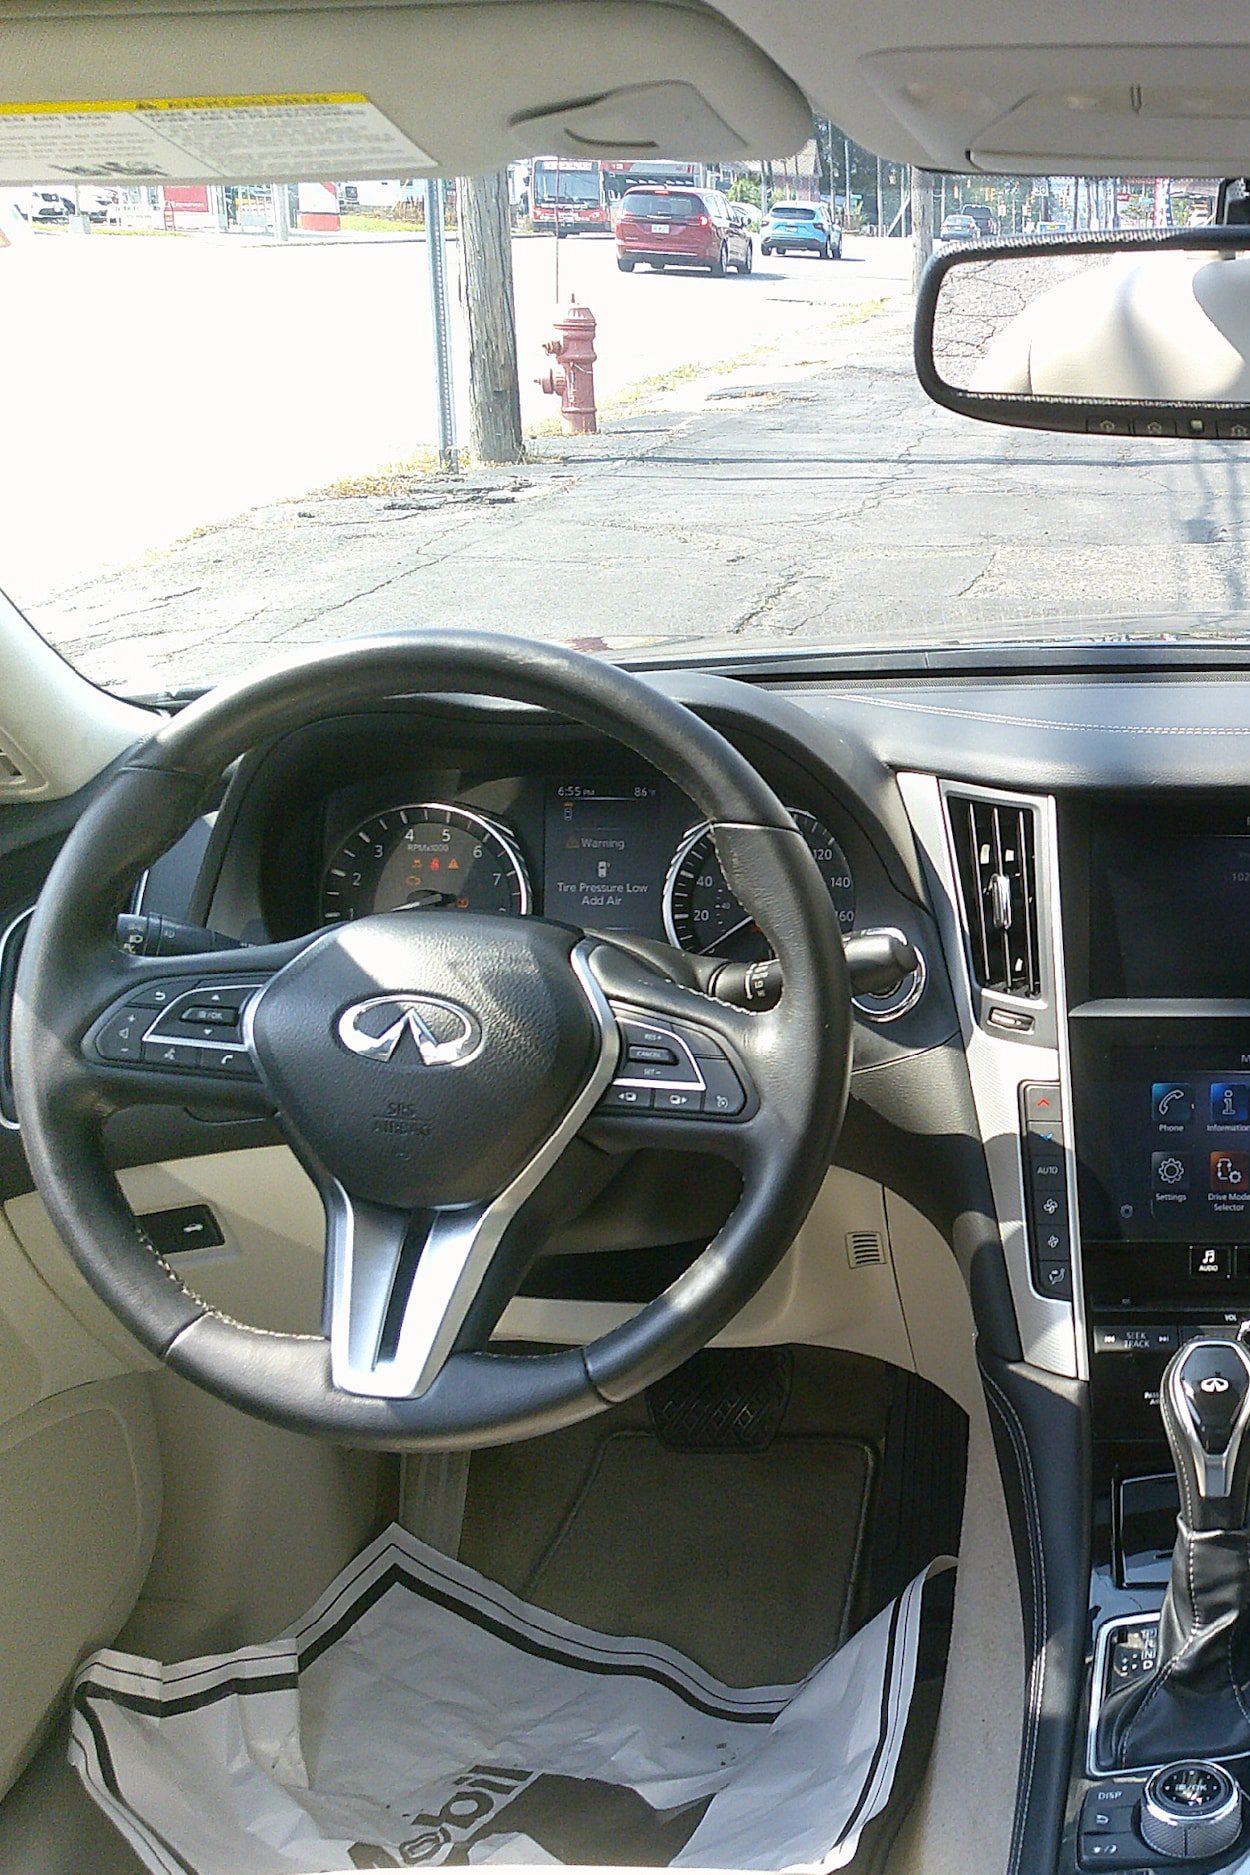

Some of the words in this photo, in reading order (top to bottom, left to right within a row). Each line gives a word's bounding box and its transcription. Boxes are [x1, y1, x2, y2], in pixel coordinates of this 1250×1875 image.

[557, 786, 581, 797] 6:55
[633, 786, 648, 797] 86
[404, 828, 415, 842] 4
[442, 828, 451, 842] 5
[581, 838, 625, 850] Warning
[374, 845, 384, 858] 3
[473, 846, 483, 859] 6
[352, 872, 362, 886] 2
[492, 873, 502, 886] 7
[696, 876, 713, 888] 40
[831, 877, 851, 888] 140
[557, 882, 577, 893] Tire
[579, 883, 624, 893] Pressure
[626, 883, 648, 893] Low
[581, 895, 604, 906] Add
[606, 895, 622, 906] Air
[693, 909, 710, 921] 20
[1159, 1123, 1185, 1133] Phone
[1037, 1165, 1059, 1175] AUTO
[1155, 1192, 1187, 1202] Settings
[1207, 1192, 1227, 1202] Drive
[1213, 1203, 1245, 1213] Selector
[1198, 1264, 1219, 1273] AUDIO
[1224, 1313, 1238, 1322] VOL
[1126, 1330, 1147, 1340] SEEK
[1123, 1338, 1151, 1349] TRACK
[1142, 1660, 1154, 1670] D
[1098, 1790, 1122, 1800] DISP
